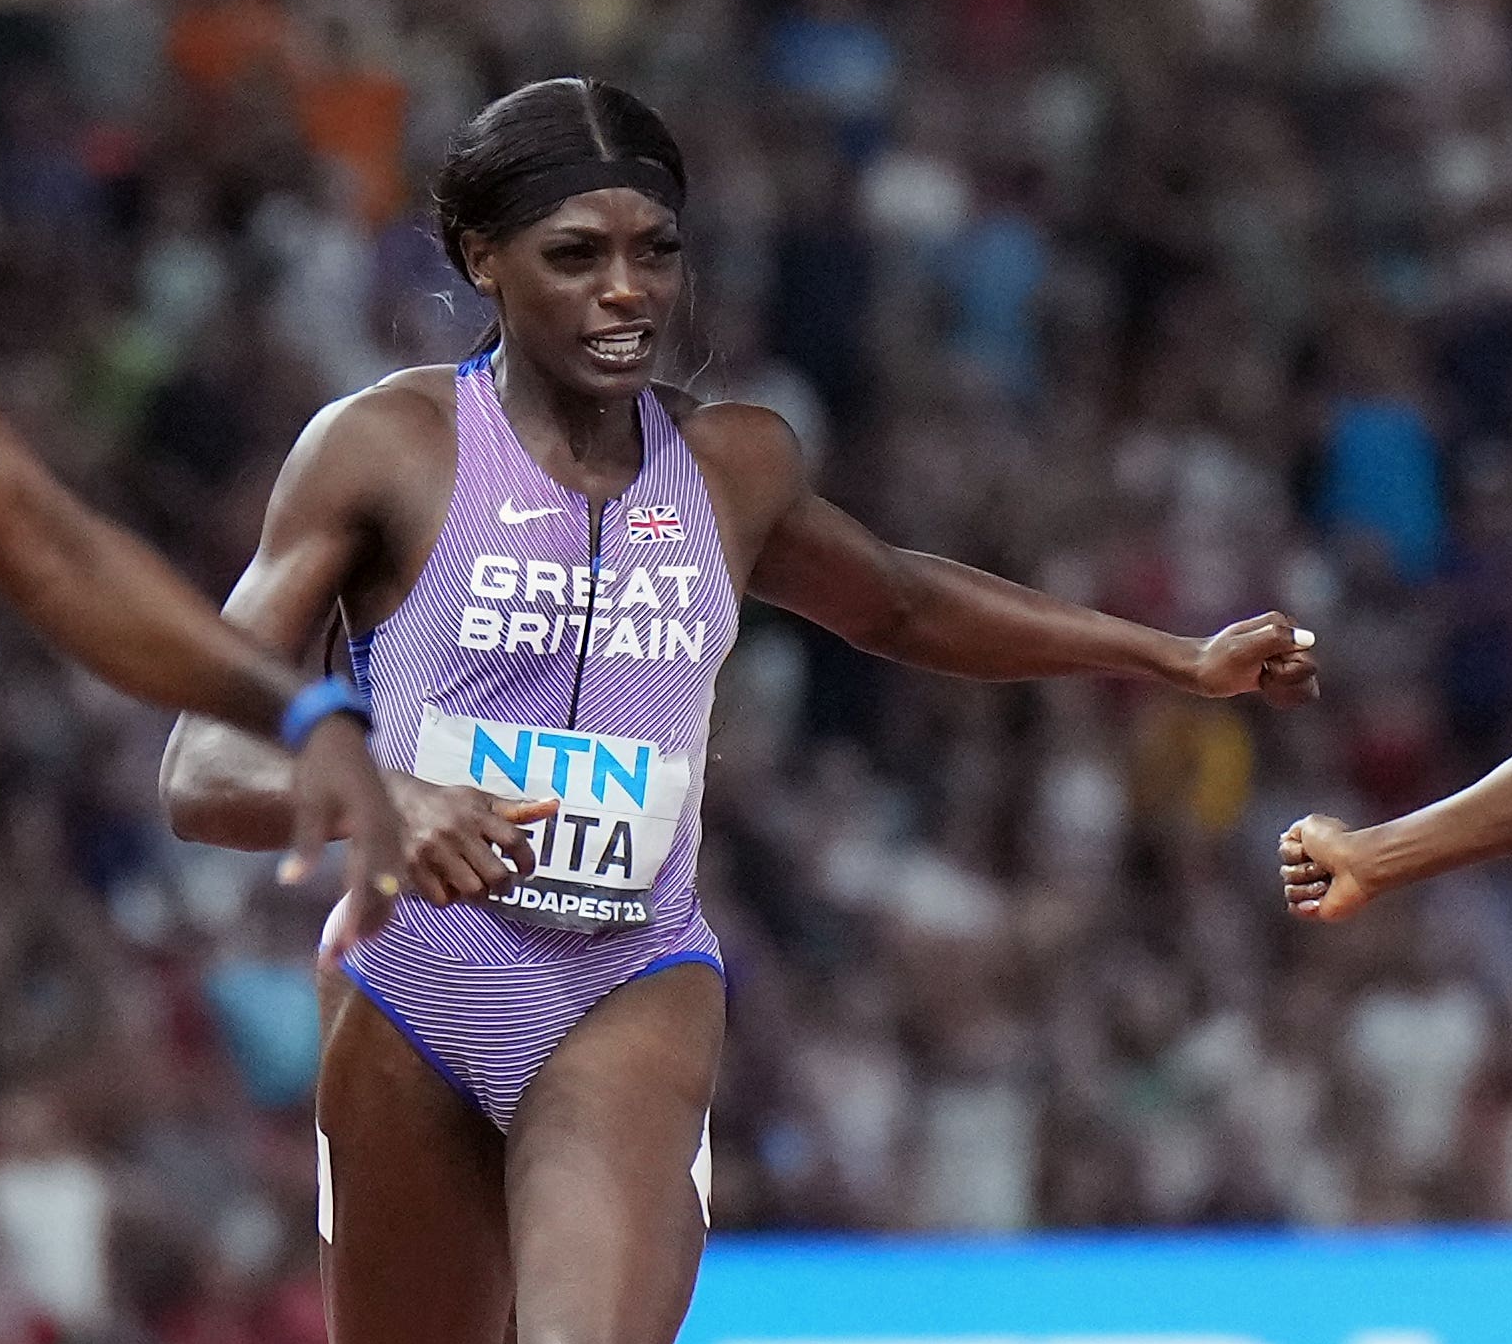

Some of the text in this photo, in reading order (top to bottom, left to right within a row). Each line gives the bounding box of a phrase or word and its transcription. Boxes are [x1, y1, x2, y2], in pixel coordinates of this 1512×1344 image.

[469, 554, 700, 611] GREAT
[457, 606, 707, 663] BRITAIN
[469, 722, 651, 811] NTN
[525, 810, 633, 880] ITA
[486, 885, 622, 922] UDAPEST
